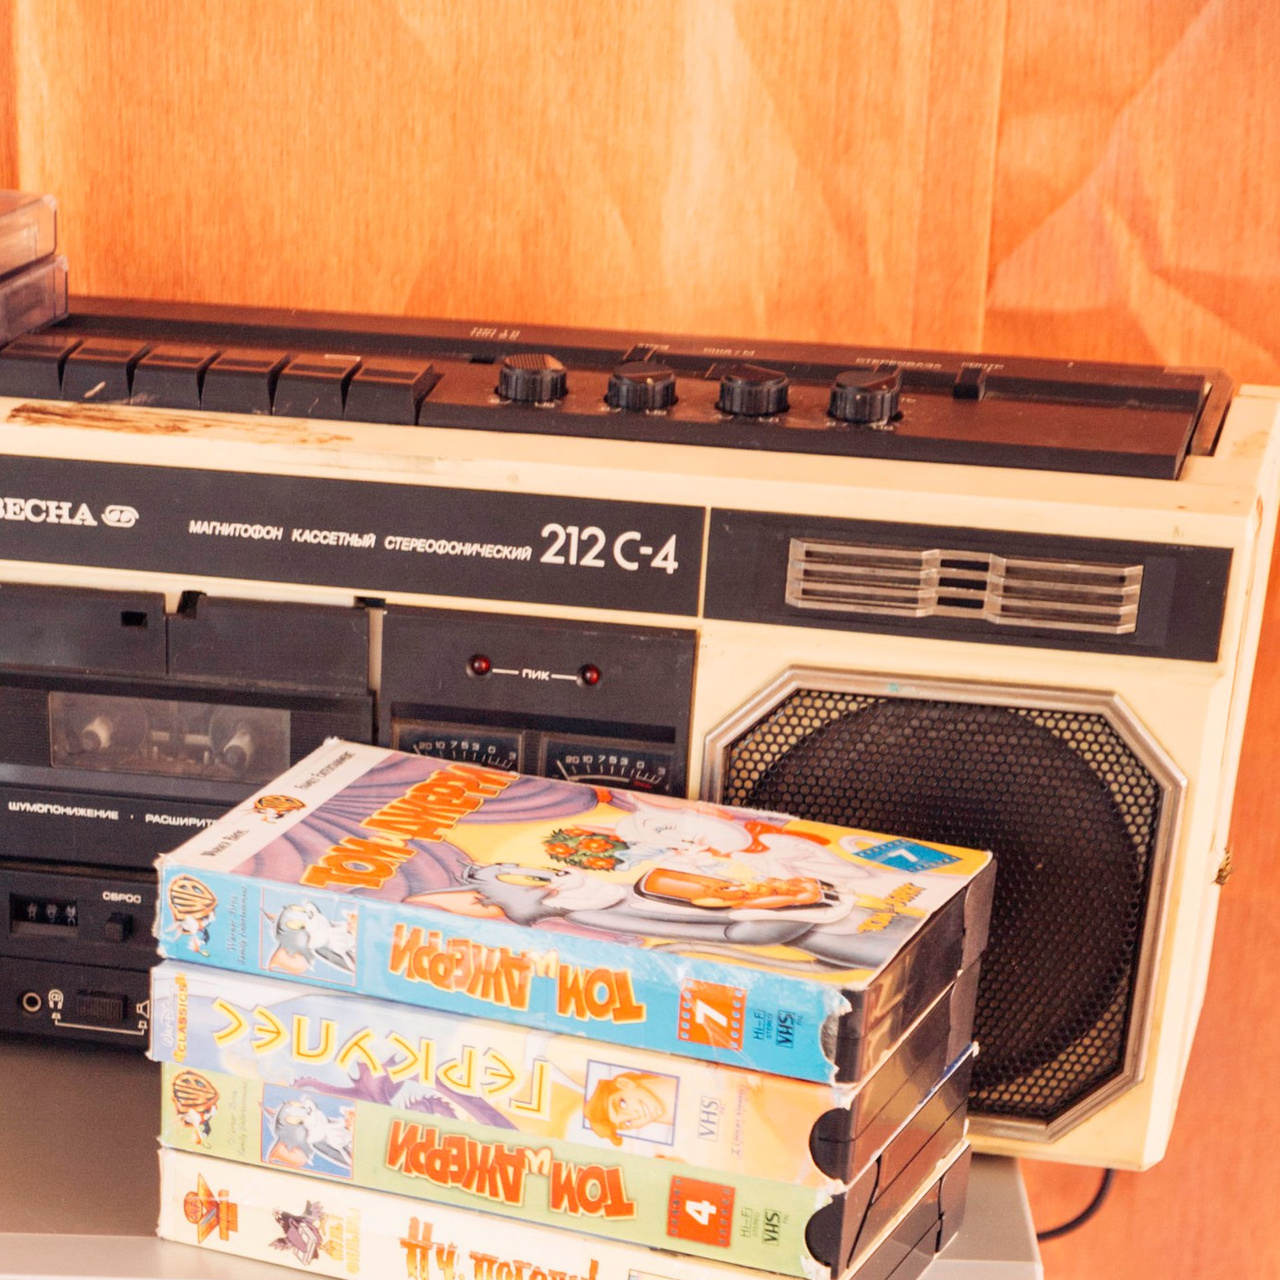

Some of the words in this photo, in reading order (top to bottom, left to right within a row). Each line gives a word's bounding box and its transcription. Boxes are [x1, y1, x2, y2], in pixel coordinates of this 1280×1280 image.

[188, 519, 284, 541] МАГНИТОФОН
[291, 528, 376, 549] КАССЕТНЫЙ
[383, 535, 533, 562] СТЕРЕОФОНИЧЕСКИЙ
[540, 522, 606, 568] 212
[522, 668, 550, 681] ПИК
[582, 754, 593, 764] 10
[8, 800, 119, 821] ШУМОПОНИЖЕНИЕ
[300, 837, 418, 890] ТОМ
[360, 763, 520, 843] ДЖЕРРИ
[102, 890, 142, 905] СБРОС
[389, 923, 533, 1012] ДЖЕРРИ
[557, 965, 646, 1024] ТОМ
[695, 999, 728, 1028] 7
[175, 982, 189, 1053] CLASSICS
[778, 1010, 795, 1049] VHS
[385, 1119, 528, 1208] ДЖЕРРИ
[549, 1161, 637, 1220] ТОМ
[685, 1199, 718, 1226] 4
[763, 1209, 780, 1246] VHS
